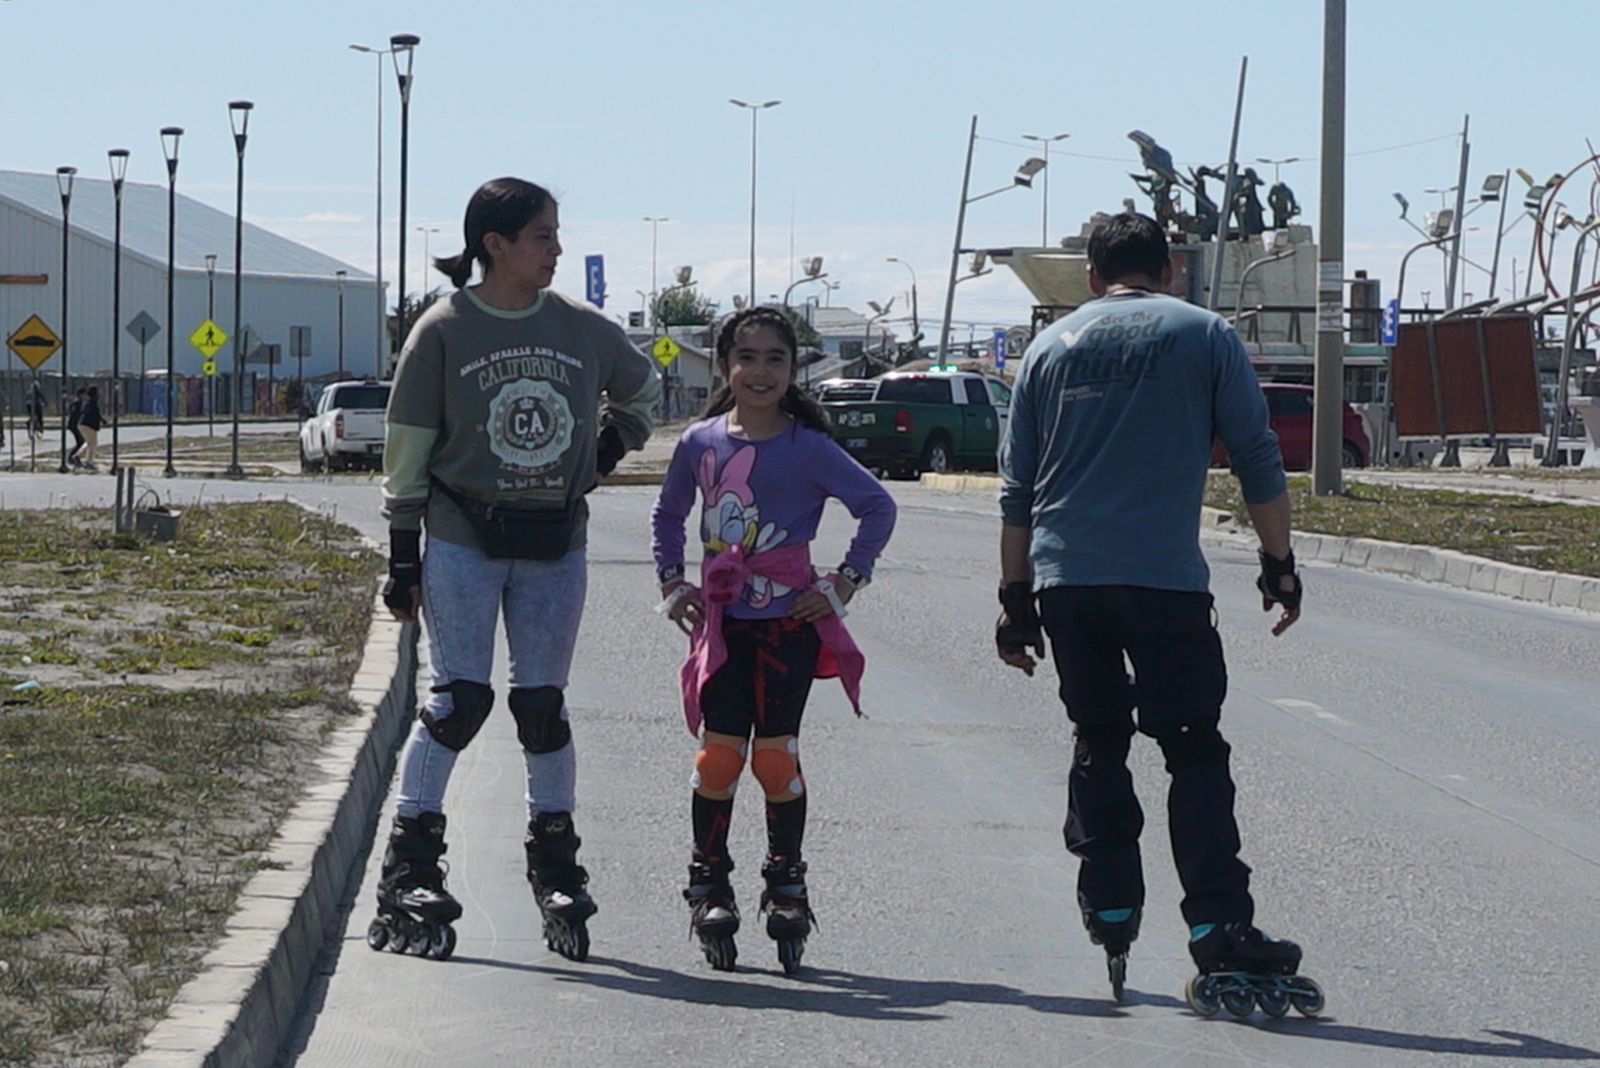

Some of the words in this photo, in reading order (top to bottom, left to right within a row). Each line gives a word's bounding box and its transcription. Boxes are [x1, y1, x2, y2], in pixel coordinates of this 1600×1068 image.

[1087, 314, 1165, 354] good
[533, 346, 554, 357] AND
[478, 357, 571, 391] CALIFORNIA
[514, 410, 545, 435] CA
